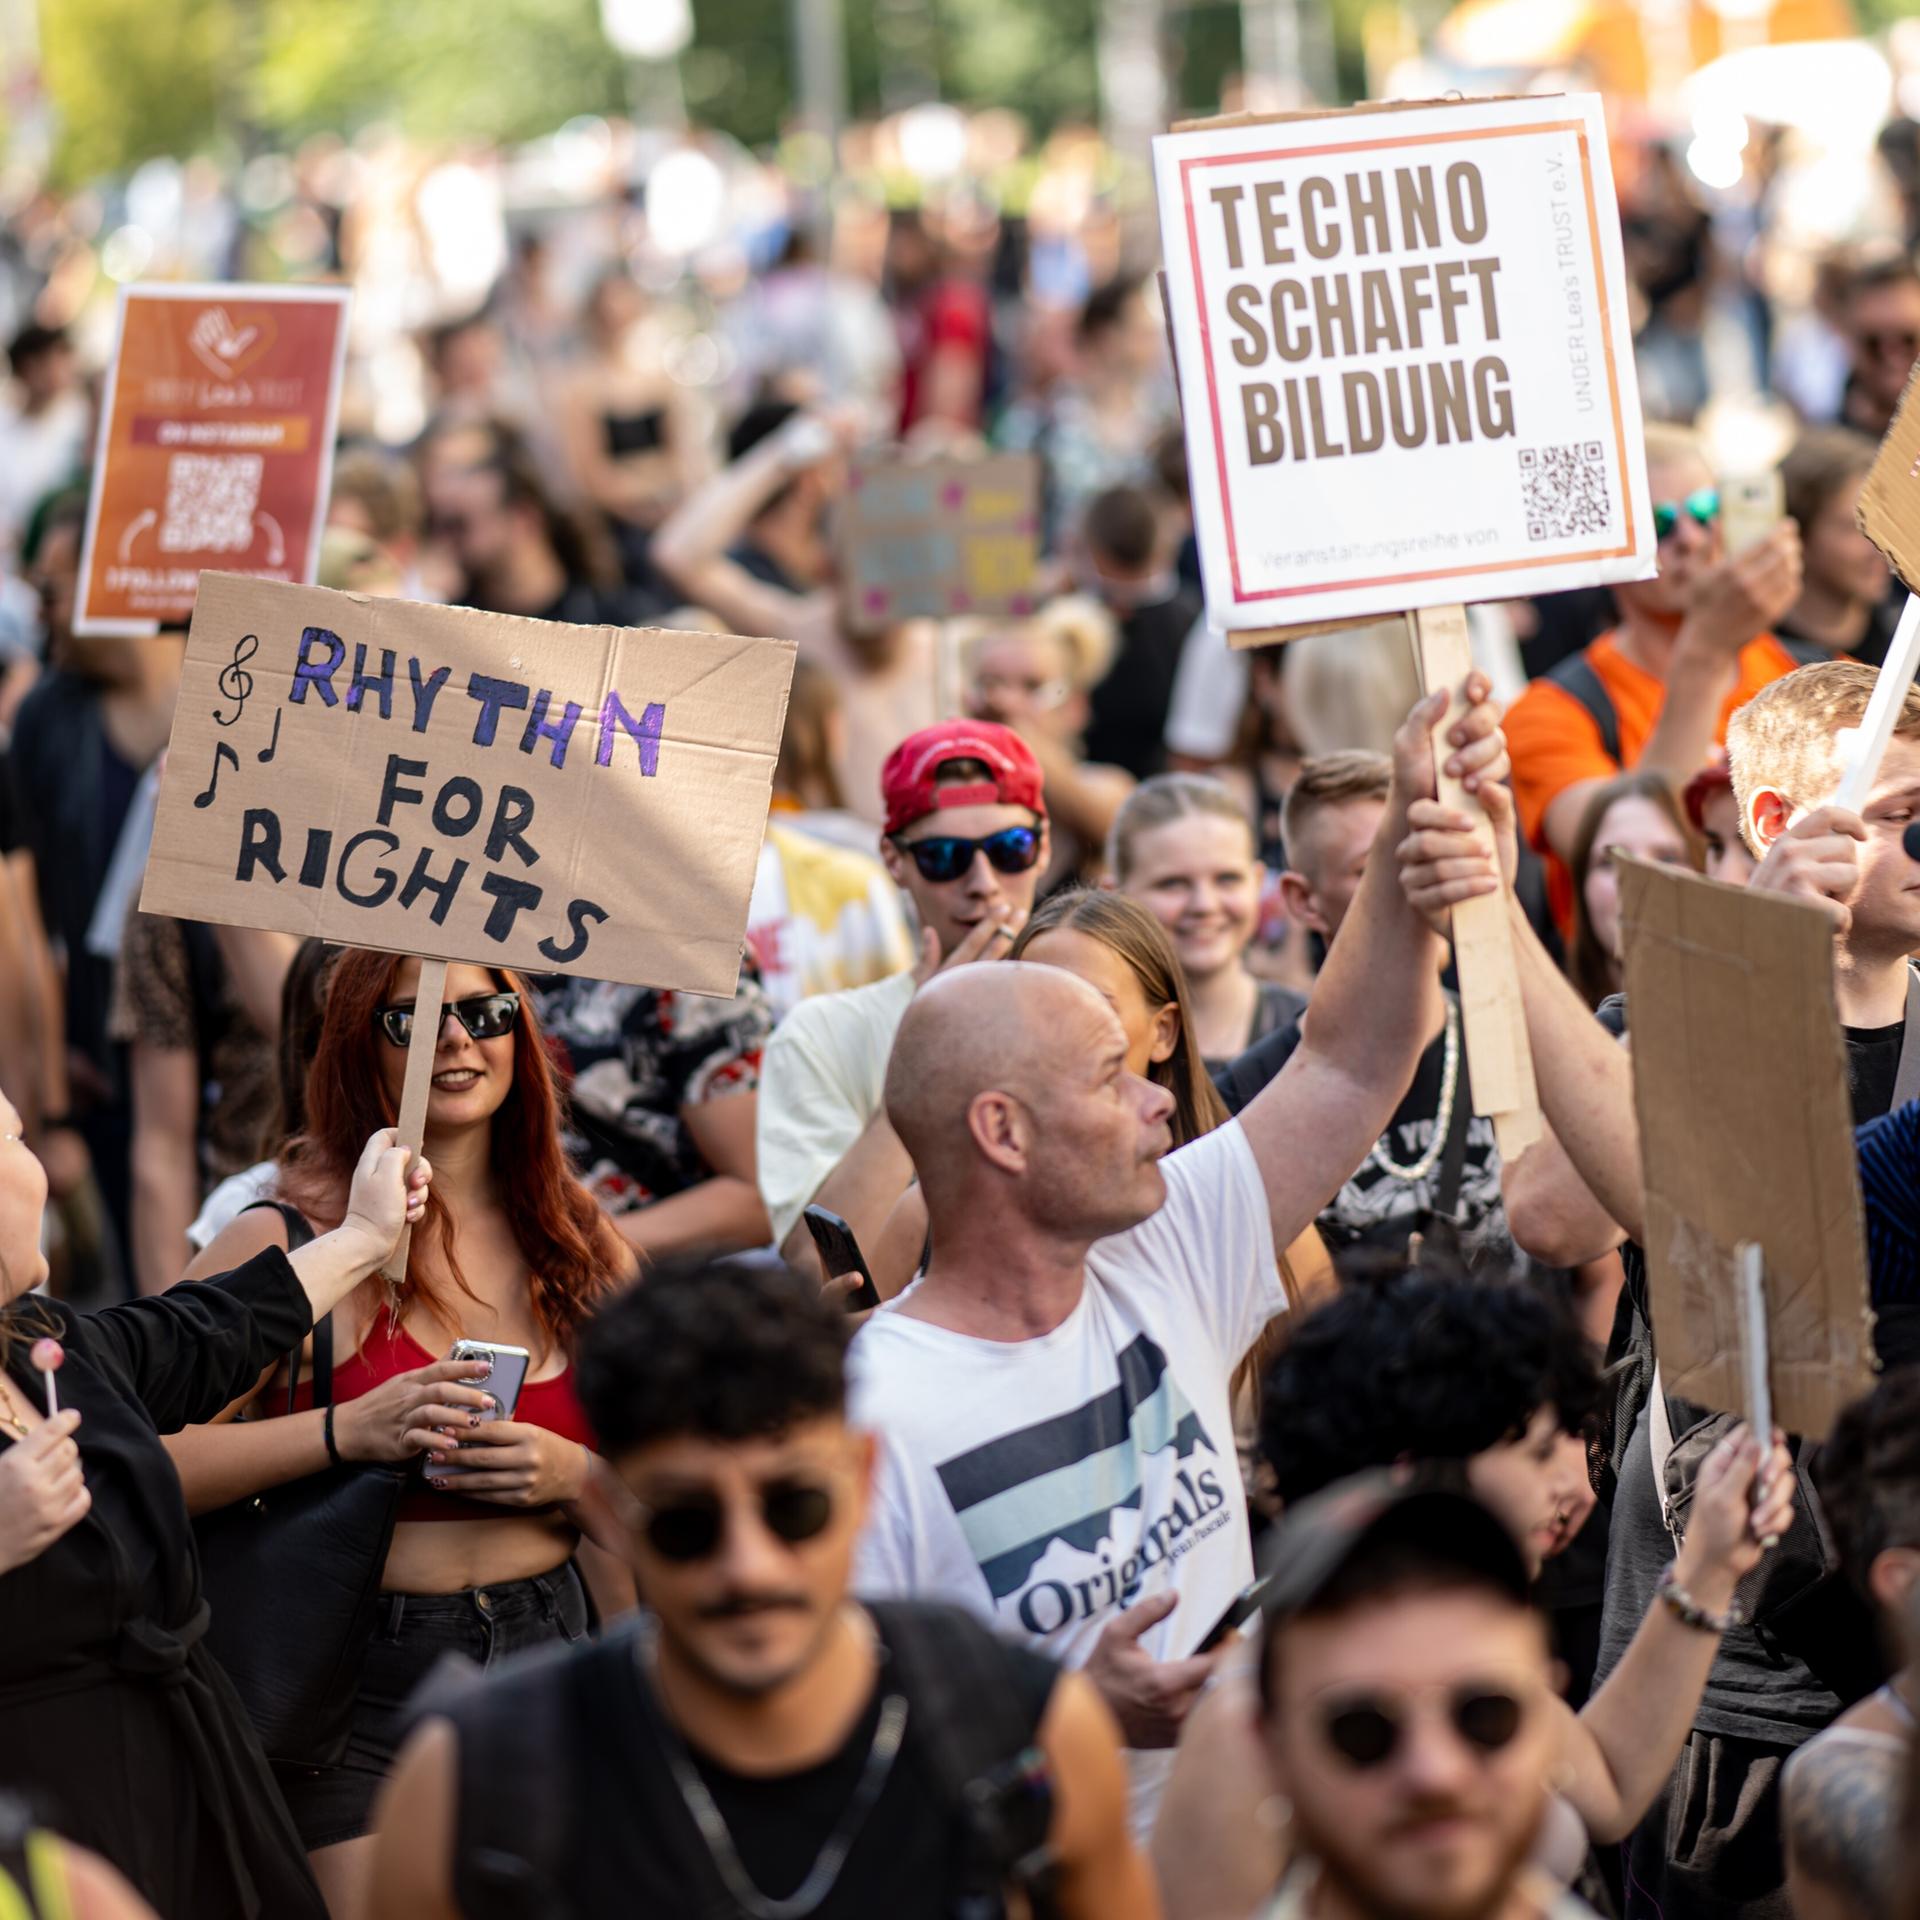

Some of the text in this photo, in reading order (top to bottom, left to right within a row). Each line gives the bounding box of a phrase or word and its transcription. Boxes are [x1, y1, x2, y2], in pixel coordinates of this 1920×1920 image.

[1209, 161, 1488, 270] TECHNO
[1226, 256, 1501, 368] SCHAFFT
[1545, 150, 1595, 413] UNDER Lea's TRUST e.V.
[1240, 355, 1517, 468] BILDUNG
[1463, 527, 1500, 547] von
[376, 753, 541, 868] FOR
[235, 807, 611, 964] RIGHTS
